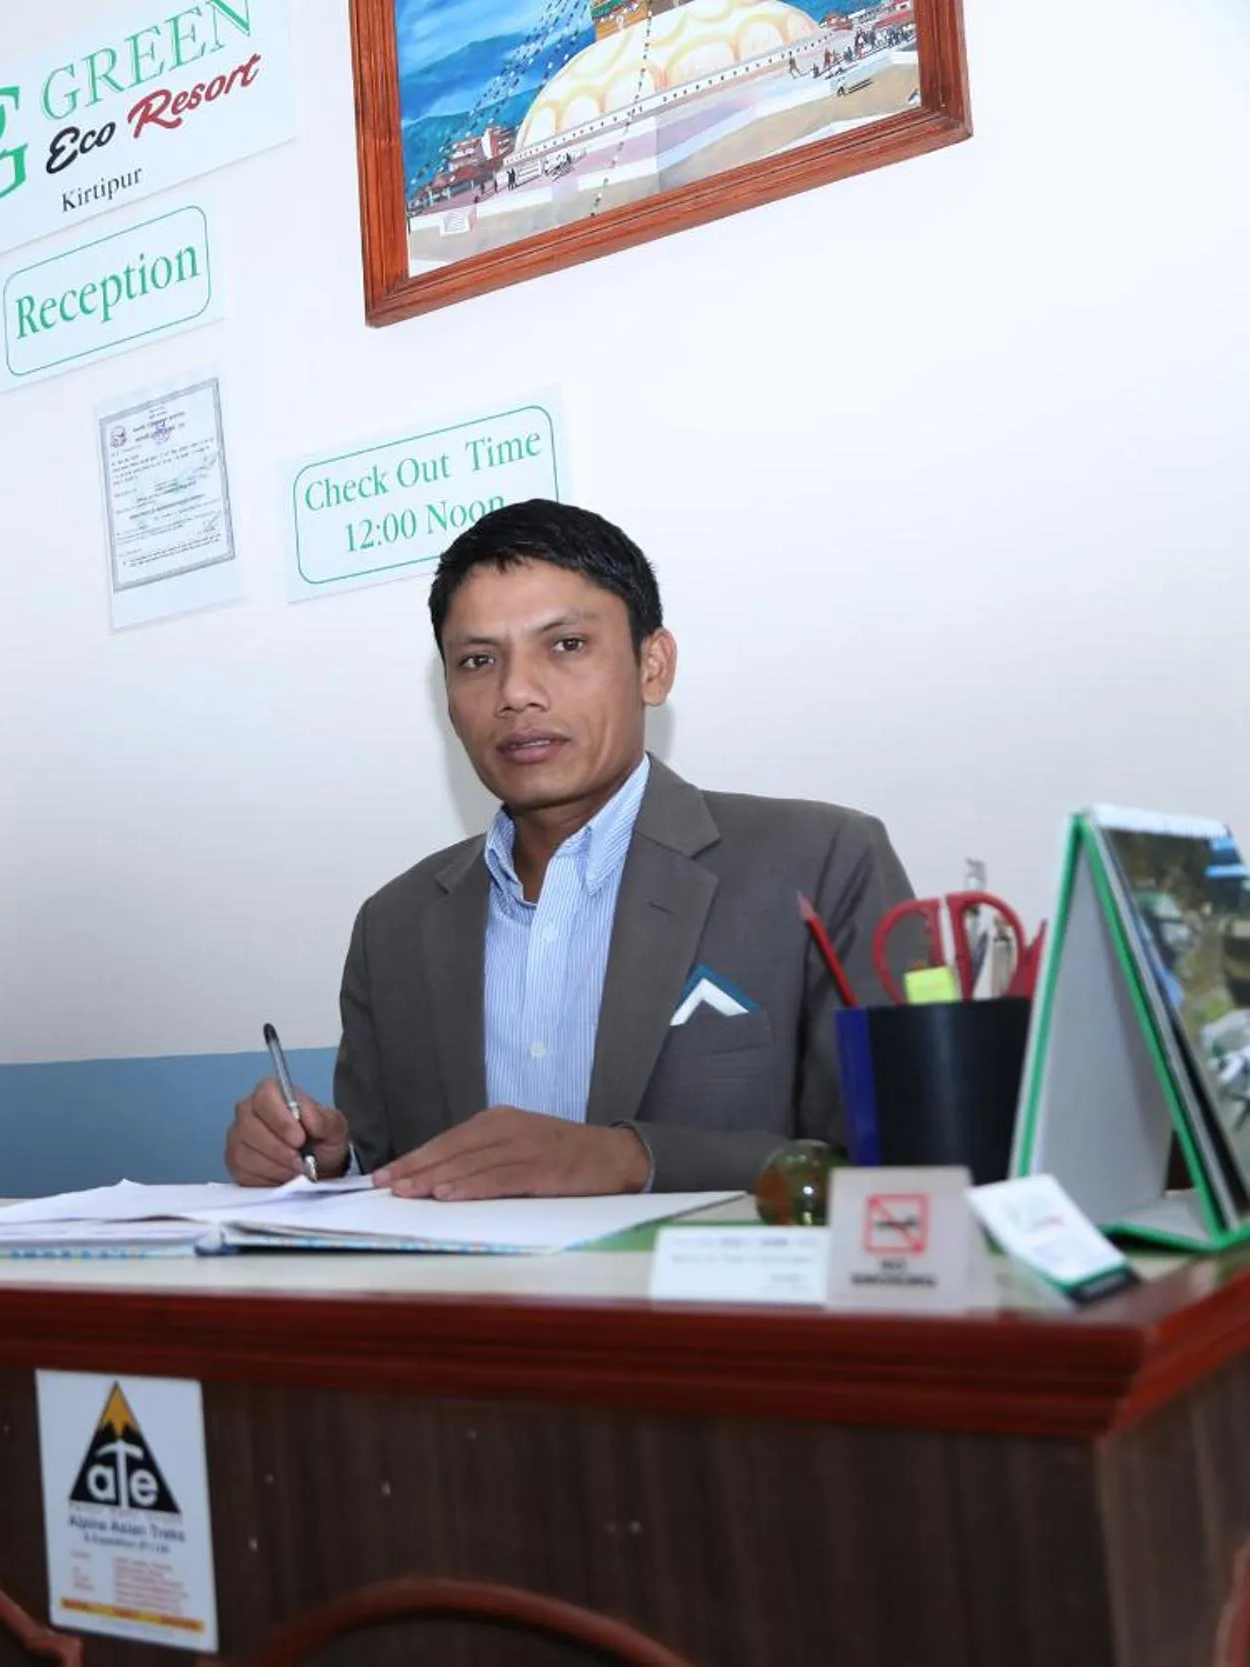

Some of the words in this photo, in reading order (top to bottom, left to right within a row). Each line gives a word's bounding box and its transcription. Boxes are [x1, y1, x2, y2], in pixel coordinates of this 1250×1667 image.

[39, 0, 252, 121] GREEN
[45, 121, 116, 174] Eco
[127, 53, 261, 138] Resort
[61, 165, 144, 212] Kirtipur
[14, 246, 201, 340] Reception
[304, 464, 389, 512] Check
[396, 452, 452, 489] Out
[465, 431, 543, 474] Time
[344, 509, 418, 555] 12:00
